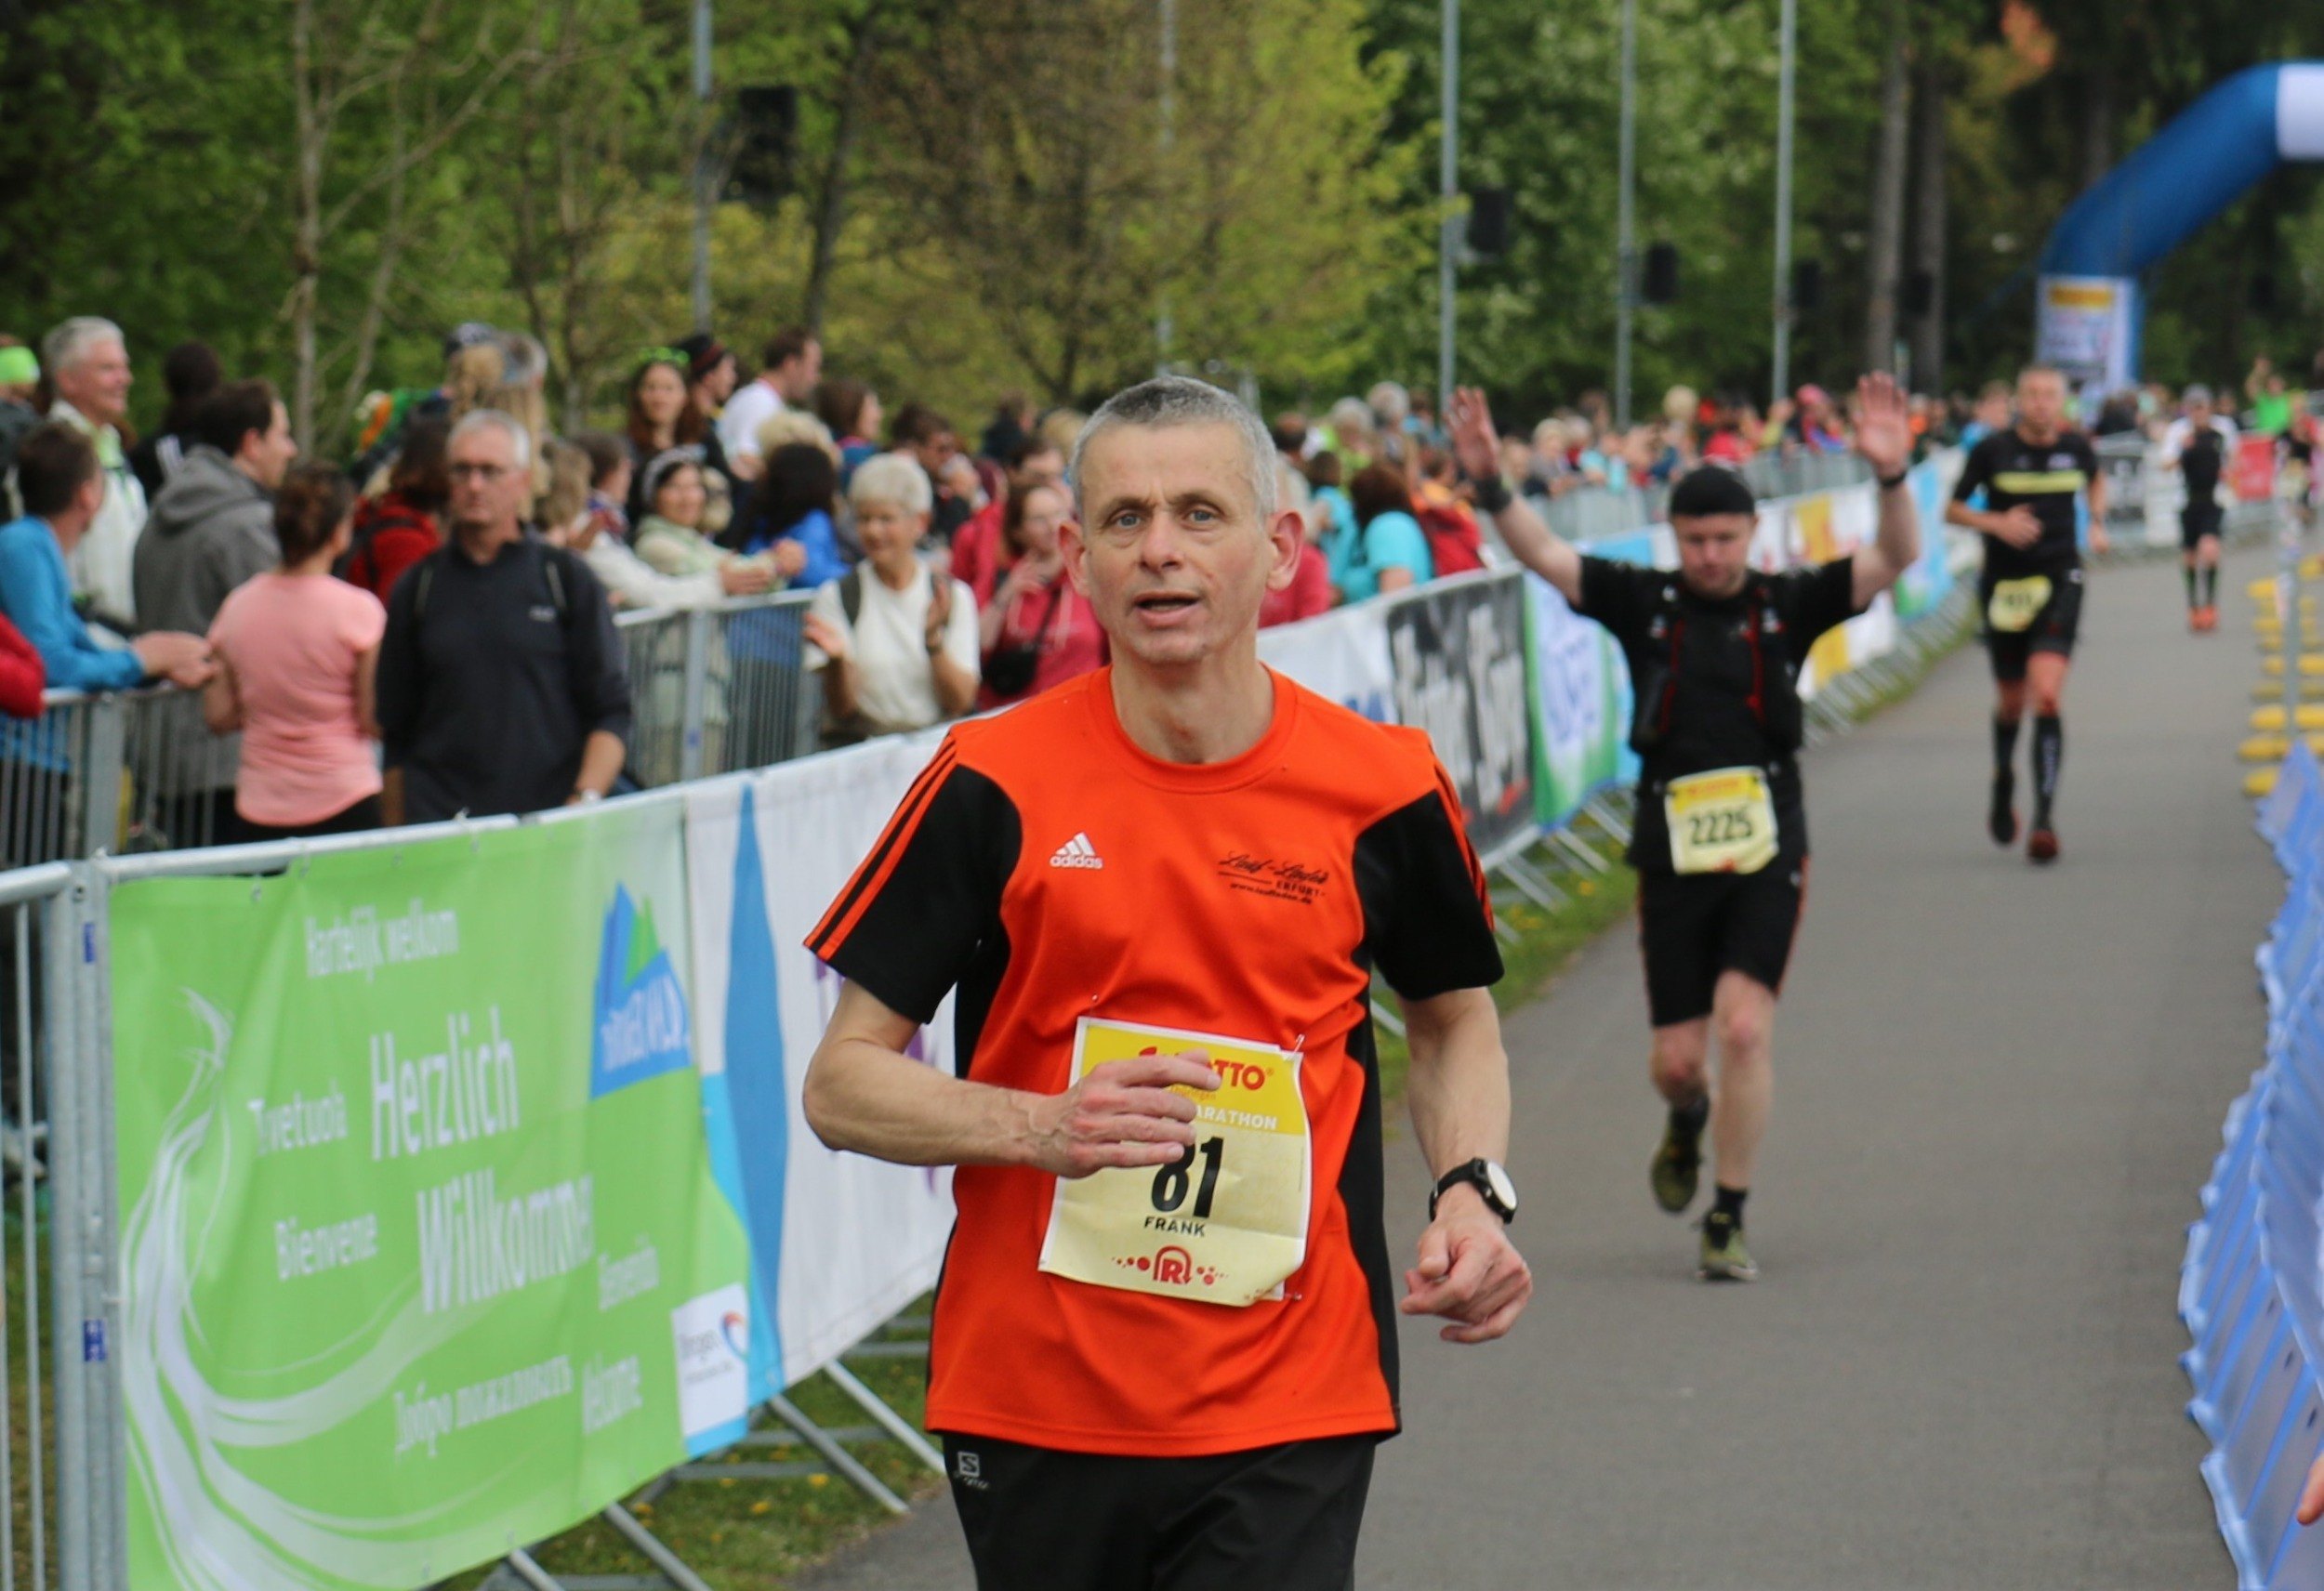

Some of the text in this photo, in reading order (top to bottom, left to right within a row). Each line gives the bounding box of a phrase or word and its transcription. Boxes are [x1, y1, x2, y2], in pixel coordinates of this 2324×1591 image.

[1689, 807, 1752, 845] 2225
[1050, 854, 1103, 869] adidas
[370, 1004, 519, 1162] Herzlich
[1206, 1058, 1265, 1091] TTO
[1195, 1104, 1277, 1130] ARATHON
[1151, 1137, 1223, 1218] 81
[1143, 1216, 1206, 1238] FRANK
